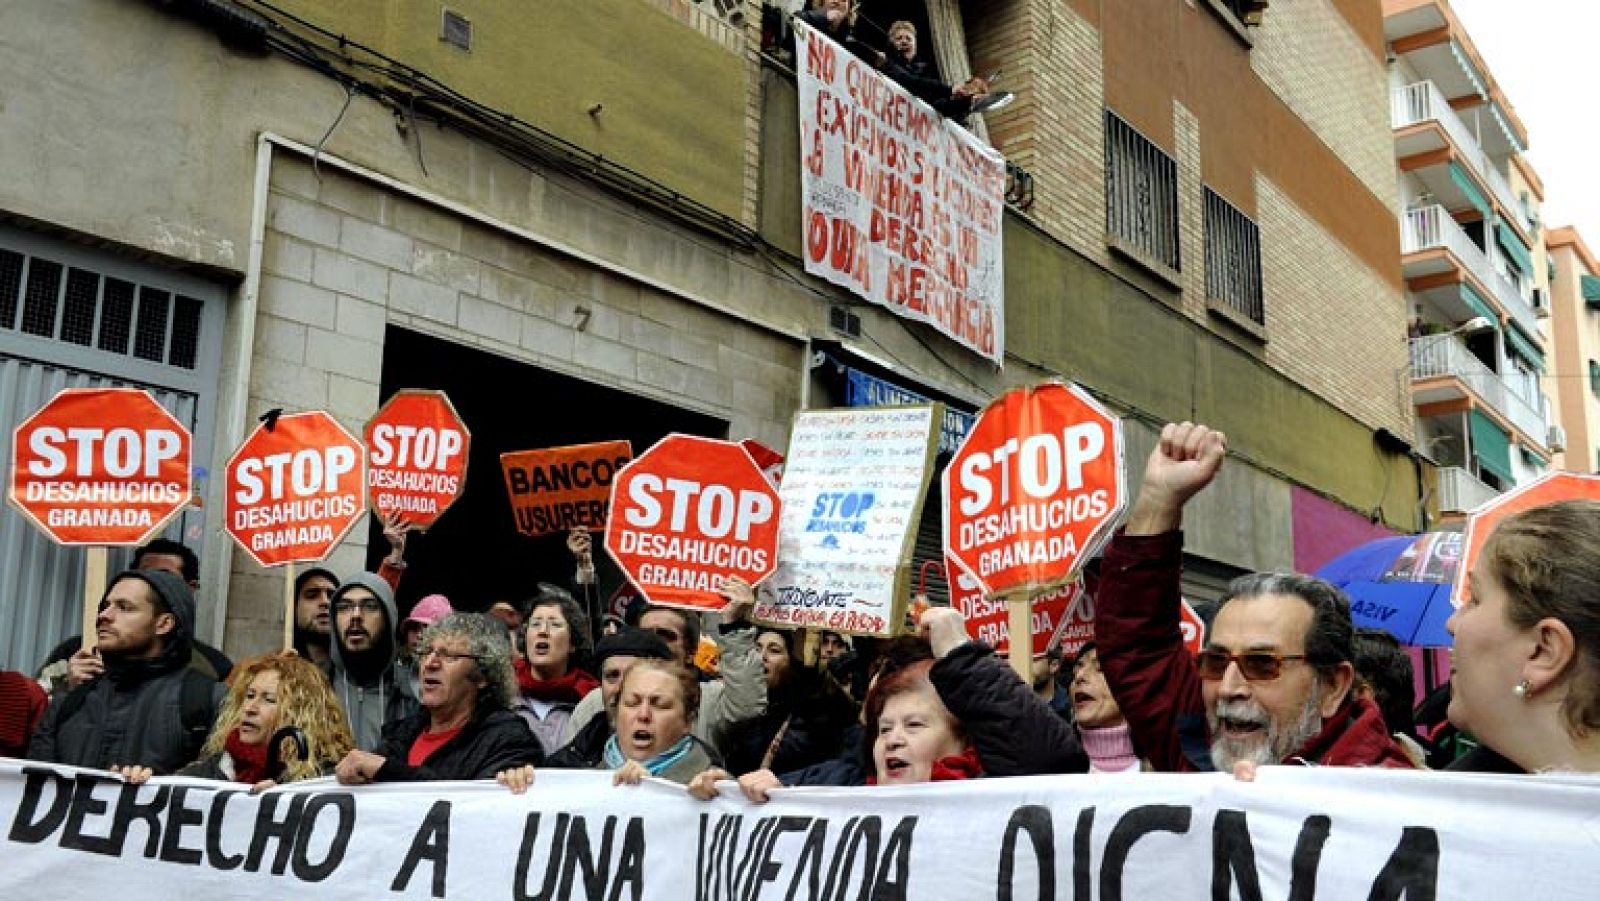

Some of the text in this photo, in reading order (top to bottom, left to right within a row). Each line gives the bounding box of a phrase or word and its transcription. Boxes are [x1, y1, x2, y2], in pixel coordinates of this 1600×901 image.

[806, 31, 836, 86] NO
[574, 304, 592, 332] 7
[28, 426, 182, 478] STOP
[370, 423, 461, 470] STOP
[235, 445, 356, 505] STOP
[368, 468, 459, 496] DESAHUCIOS
[959, 421, 1105, 517] STOP
[26, 481, 181, 503] DESAHUCIOS
[234, 494, 356, 530] DESAHUCIOS
[378, 493, 438, 514] GRANADA
[625, 472, 774, 541] STOP
[812, 492, 875, 518] STOP
[48, 508, 153, 528] GRANADA
[251, 526, 334, 552] GRANADA
[959, 489, 1109, 551] DESAHUCIOS
[620, 530, 768, 573] DESAHUCIOS
[978, 532, 1078, 577] GRANADA
[639, 563, 724, 593] GRANAD
[8, 766, 356, 882] DERECHO
[390, 799, 451, 898] A
[512, 811, 645, 901] UNA
